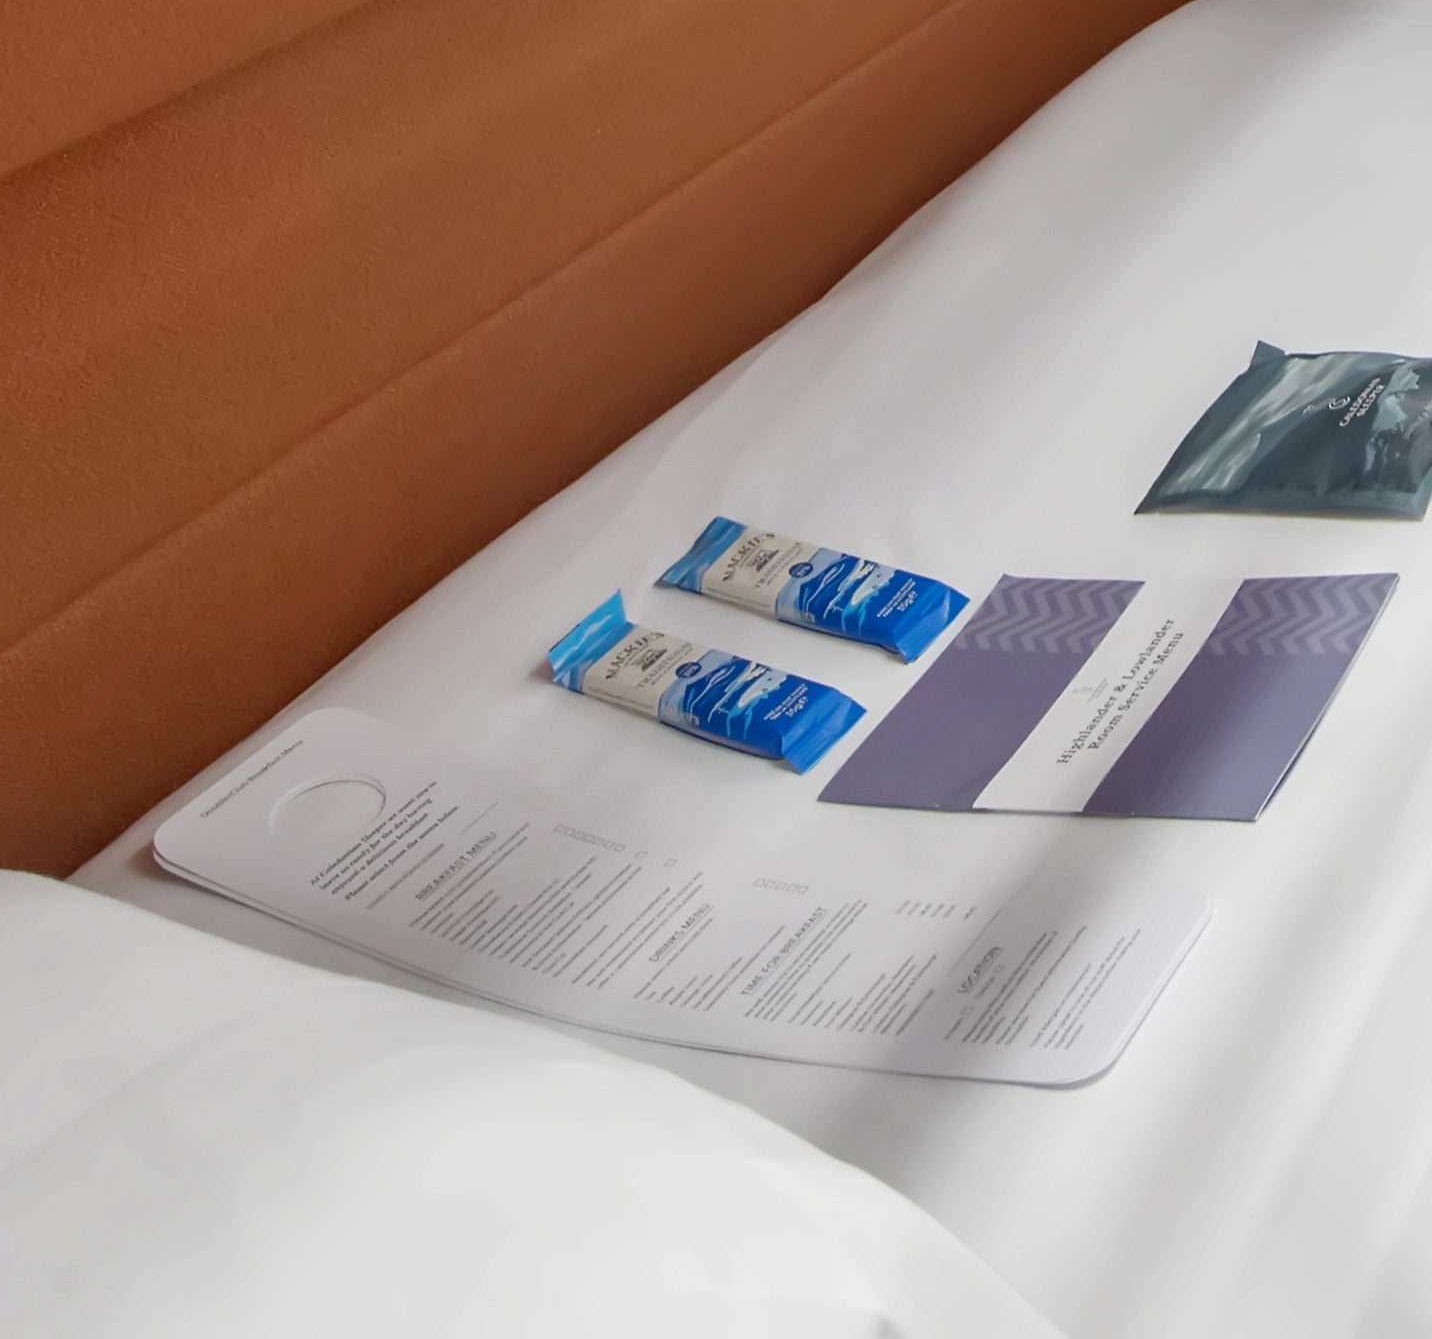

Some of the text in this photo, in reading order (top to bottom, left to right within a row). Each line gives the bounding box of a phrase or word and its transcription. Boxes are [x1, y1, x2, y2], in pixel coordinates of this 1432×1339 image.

[1056, 695, 1118, 764] Highlander
[1113, 683, 1126, 694] &
[1122, 618, 1175, 681] Lowlander
[1088, 713, 1123, 750] Room
[1118, 667, 1158, 713] Service
[1152, 631, 1184, 666] Menu
[415, 855, 468, 900] BREAKFAST
[466, 831, 496, 856] MENU
[648, 903, 710, 963] DRINKS MENU
[740, 906, 827, 995] TIME FOR BREAKFAST
[956, 946, 1001, 994] LOCATION
